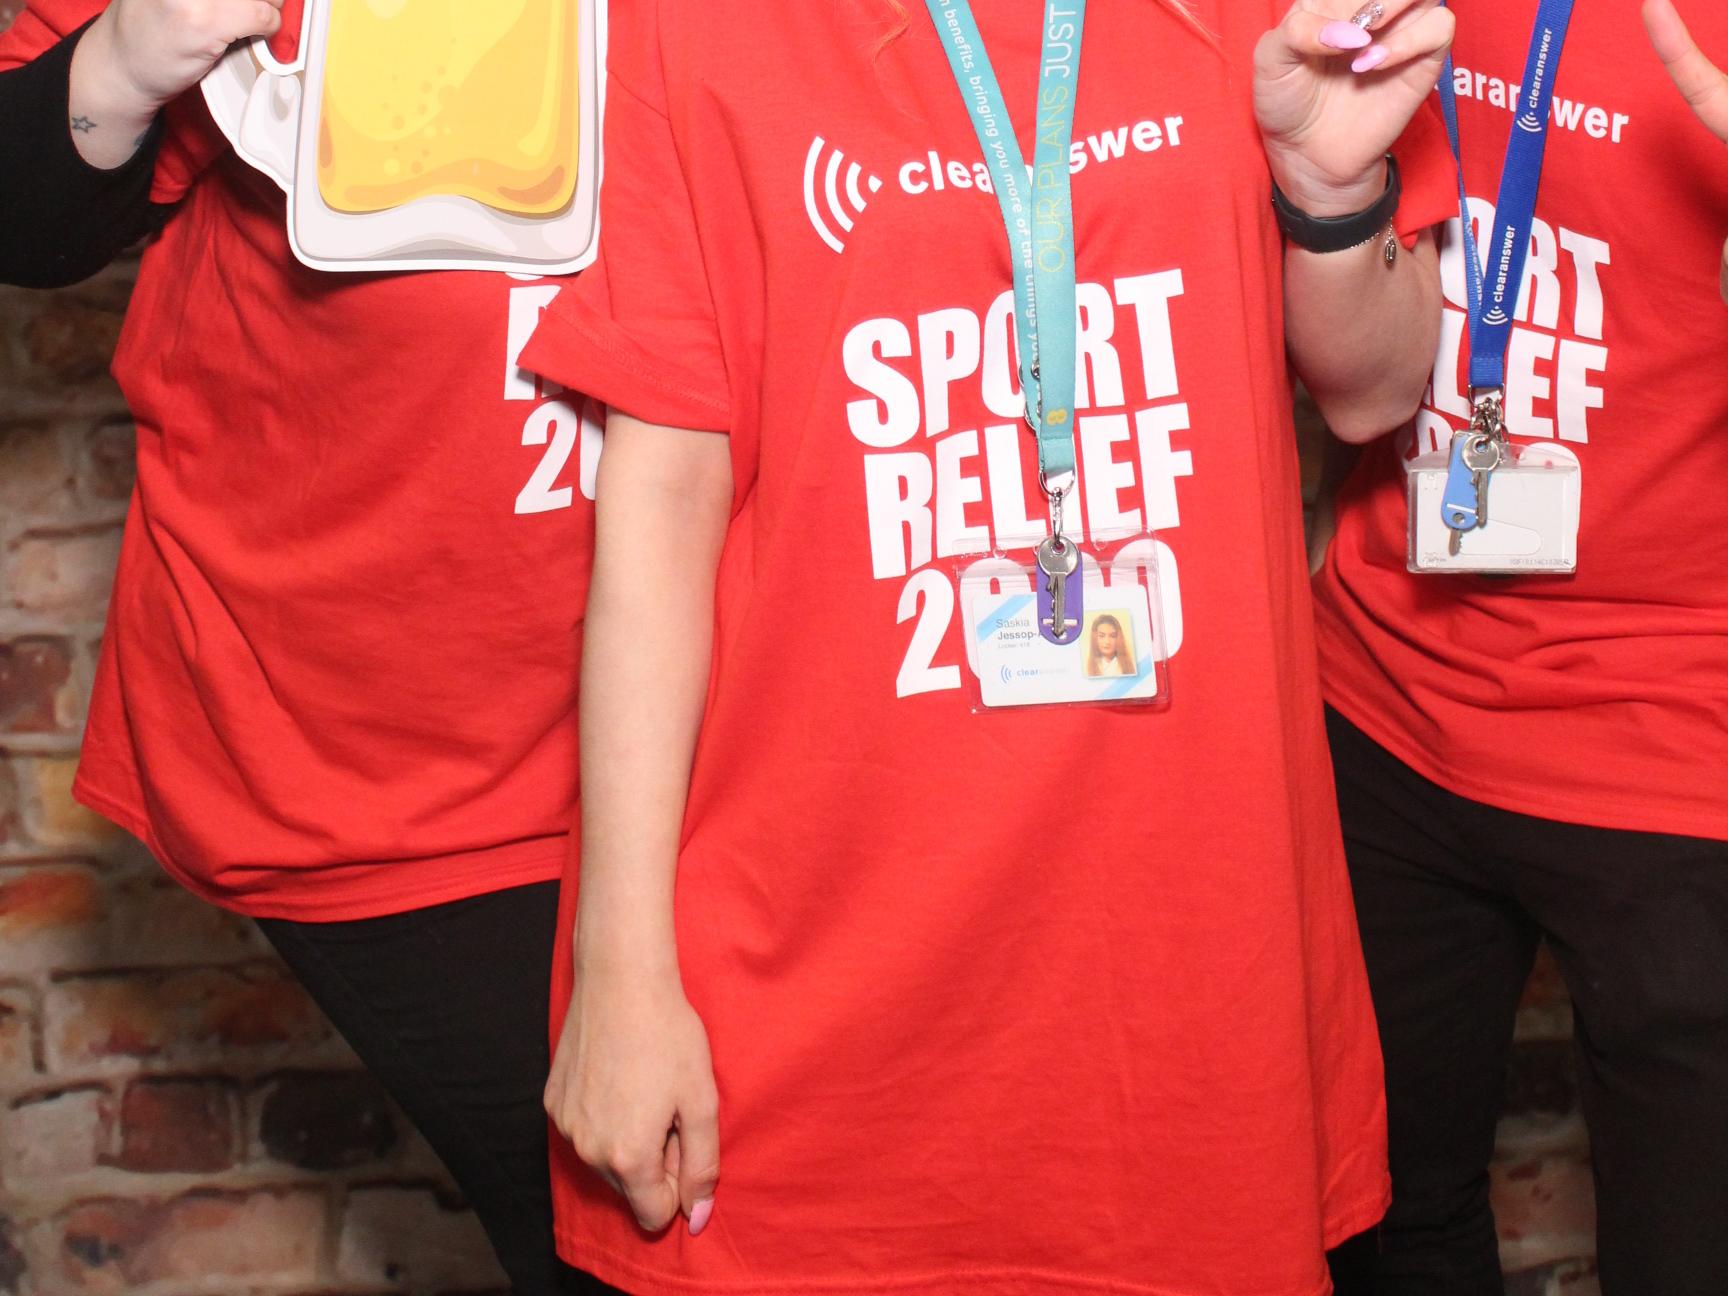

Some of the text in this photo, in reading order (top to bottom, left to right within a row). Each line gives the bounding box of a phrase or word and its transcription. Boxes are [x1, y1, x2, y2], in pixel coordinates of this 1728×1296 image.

[1044, 3, 1077, 78] JUST
[1528, 27, 1553, 109] clearanswer
[944, 8, 975, 73] benefits,
[969, 75, 999, 137] bringing
[989, 141, 1011, 170] you
[1003, 173, 1023, 214] more
[1016, 217, 1030, 237] of
[1037, 86, 1070, 191] PLANS
[1036, 198, 1067, 273] OUR
[1492, 224, 1517, 303] clearanswer
